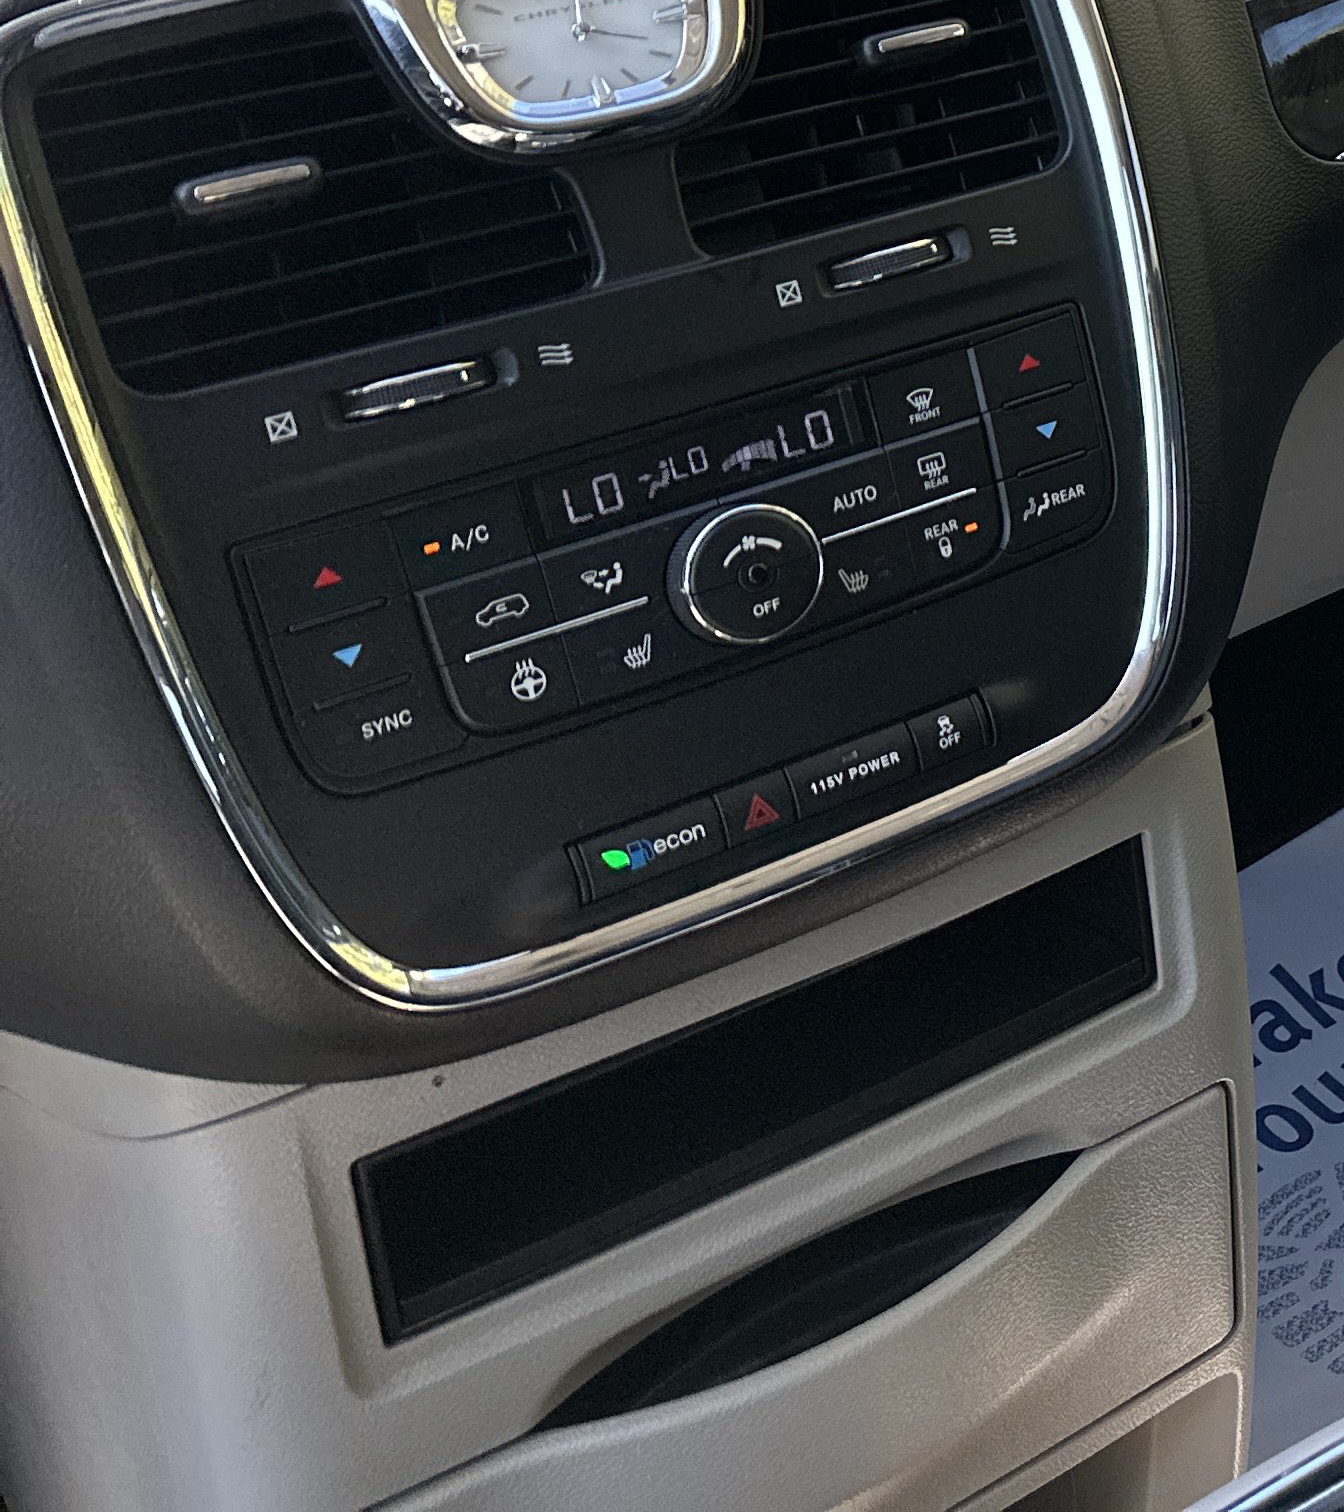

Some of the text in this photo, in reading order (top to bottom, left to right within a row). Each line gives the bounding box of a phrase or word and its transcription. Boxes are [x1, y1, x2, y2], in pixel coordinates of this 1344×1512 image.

[909, 405, 941, 424] FRONT
[778, 409, 834, 458] LO
[925, 474, 949, 490] REAR
[1051, 484, 1086, 506] REAR
[563, 473, 624, 524] LO
[833, 485, 878, 513] AUTO
[451, 524, 489, 552] A/C
[924, 519, 958, 541] REAR
[753, 598, 781, 617] OFF
[362, 710, 413, 740] SYNC
[939, 731, 962, 750] OFF
[810, 751, 901, 796] 115V POWER
[652, 823, 706, 856] econ
